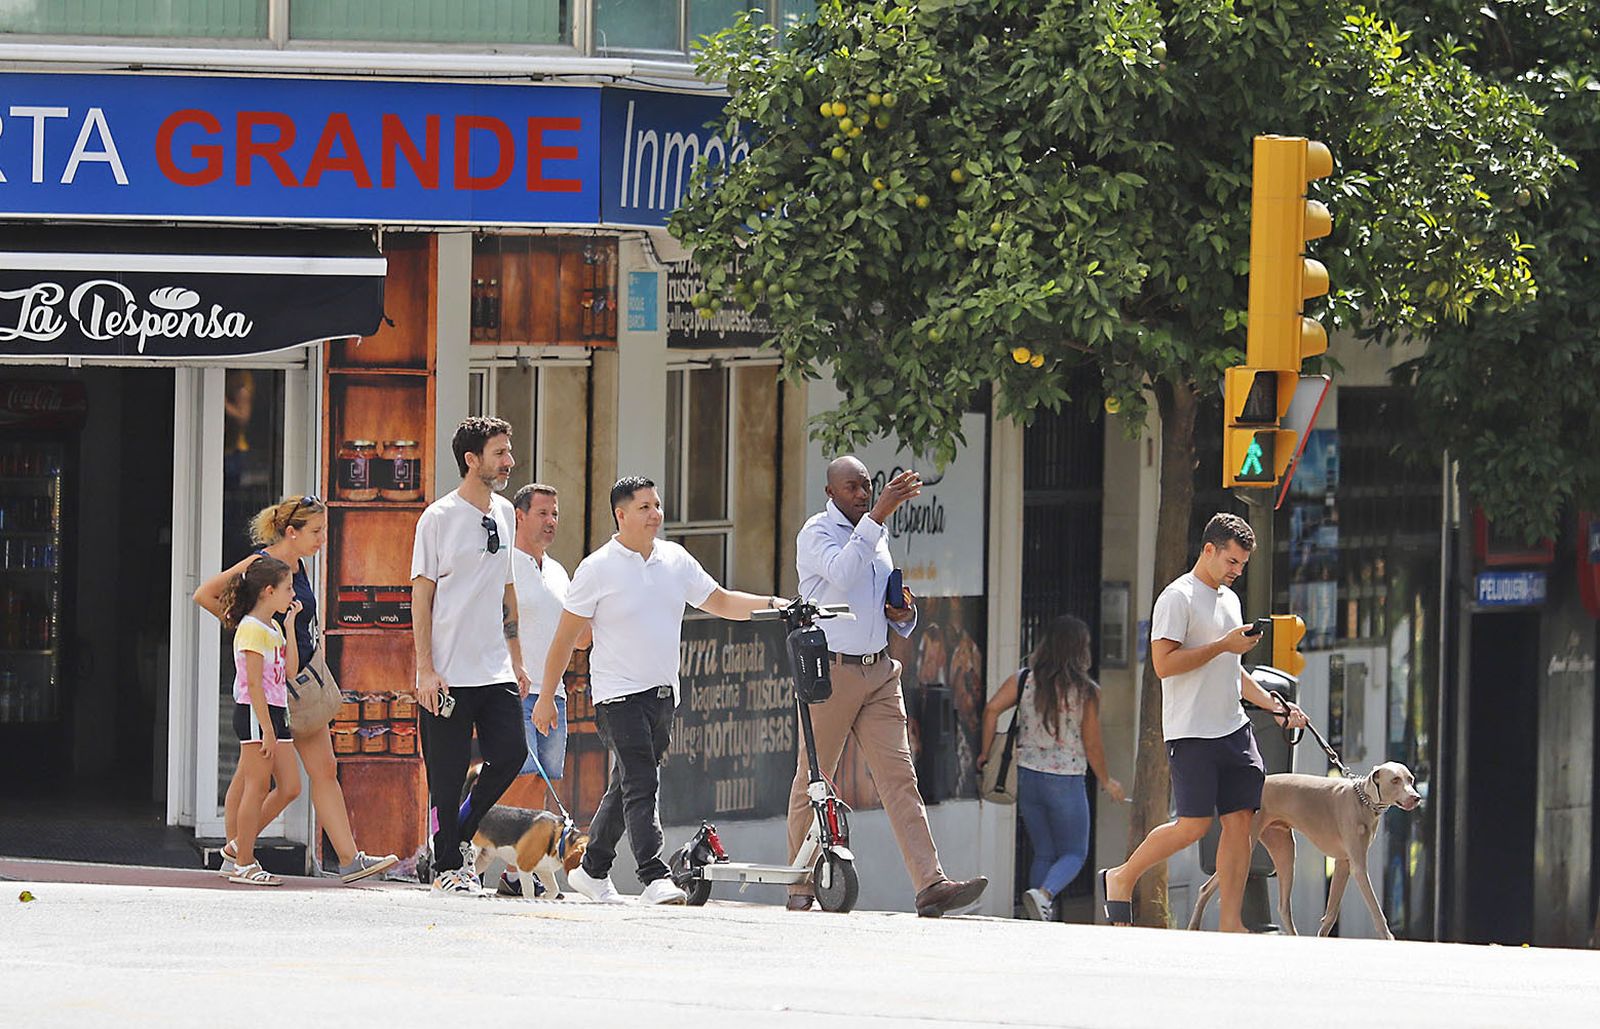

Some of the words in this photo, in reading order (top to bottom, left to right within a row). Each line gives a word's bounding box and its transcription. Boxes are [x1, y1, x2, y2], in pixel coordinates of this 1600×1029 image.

[155, 108, 583, 193] GRANDE
[0, 282, 68, 342] La
[68, 279, 254, 354] Despensa
